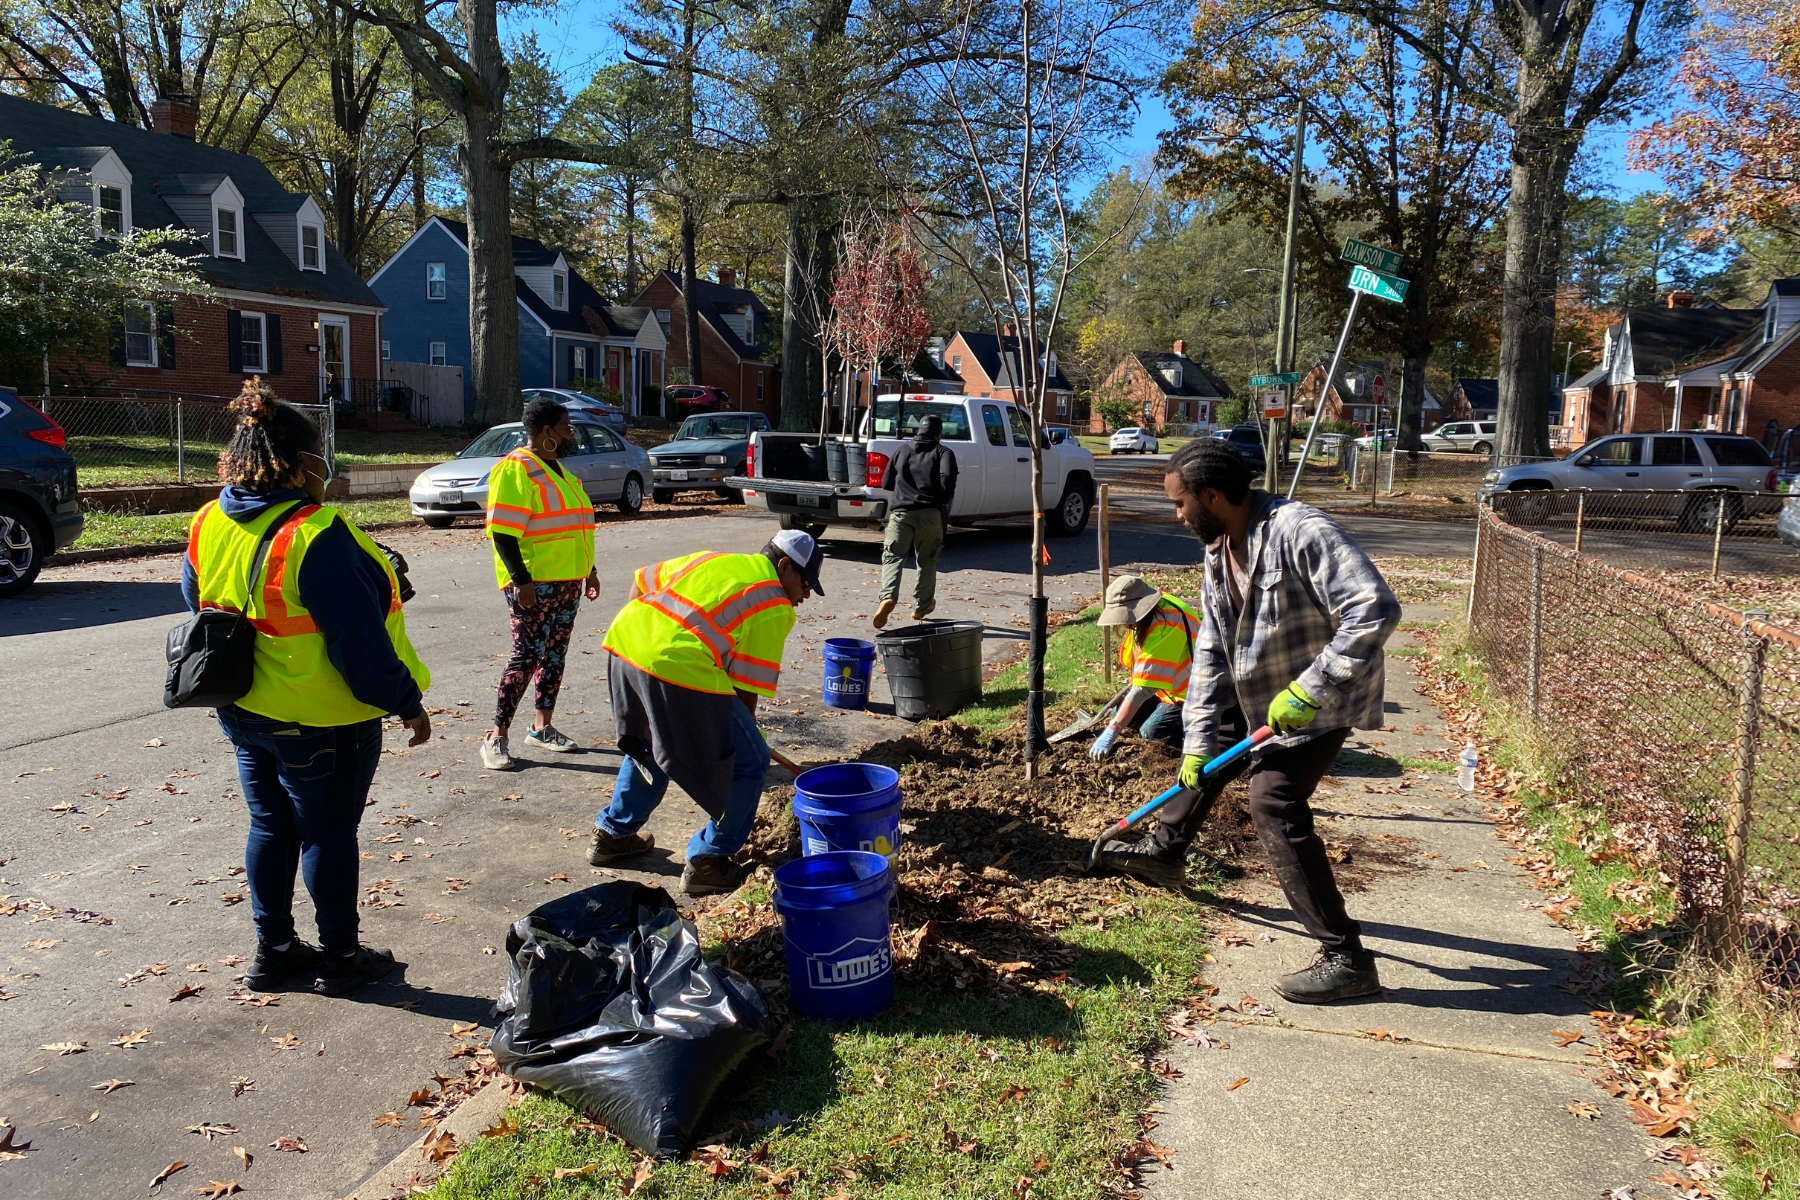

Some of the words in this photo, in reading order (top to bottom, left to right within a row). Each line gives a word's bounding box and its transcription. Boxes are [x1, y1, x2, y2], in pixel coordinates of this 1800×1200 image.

[1345, 242, 1385, 267] DAWSON
[1393, 256, 1400, 264] RD
[1350, 268, 1381, 291] URN
[1395, 281, 1405, 290] RD
[1251, 375, 1283, 385] RYBURN
[828, 679, 861, 693] LOWE'S
[817, 948, 889, 983] LOWE'S
